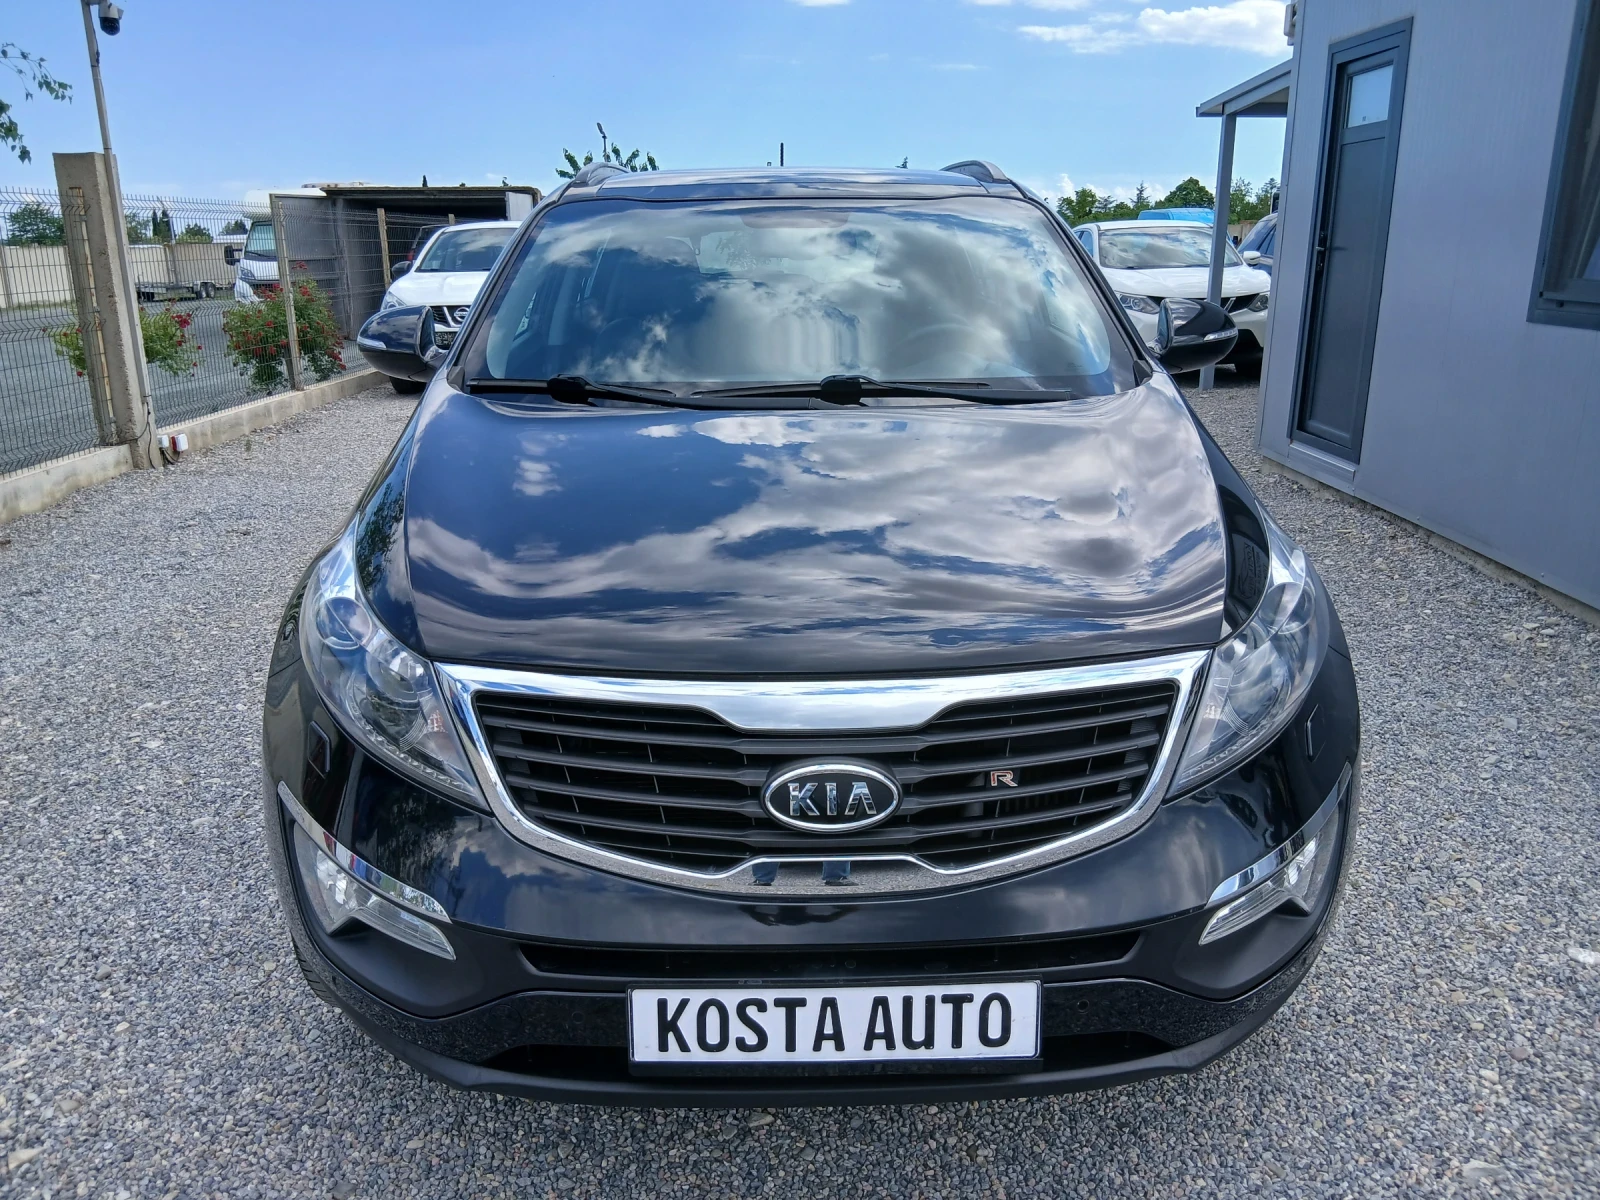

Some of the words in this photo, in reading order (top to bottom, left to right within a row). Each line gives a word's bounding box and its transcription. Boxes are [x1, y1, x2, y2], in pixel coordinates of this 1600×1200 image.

[990, 770, 1019, 787] R
[788, 781, 877, 816] KIA
[657, 997, 846, 1053] KOSTA
[863, 992, 1013, 1051] AUTO
